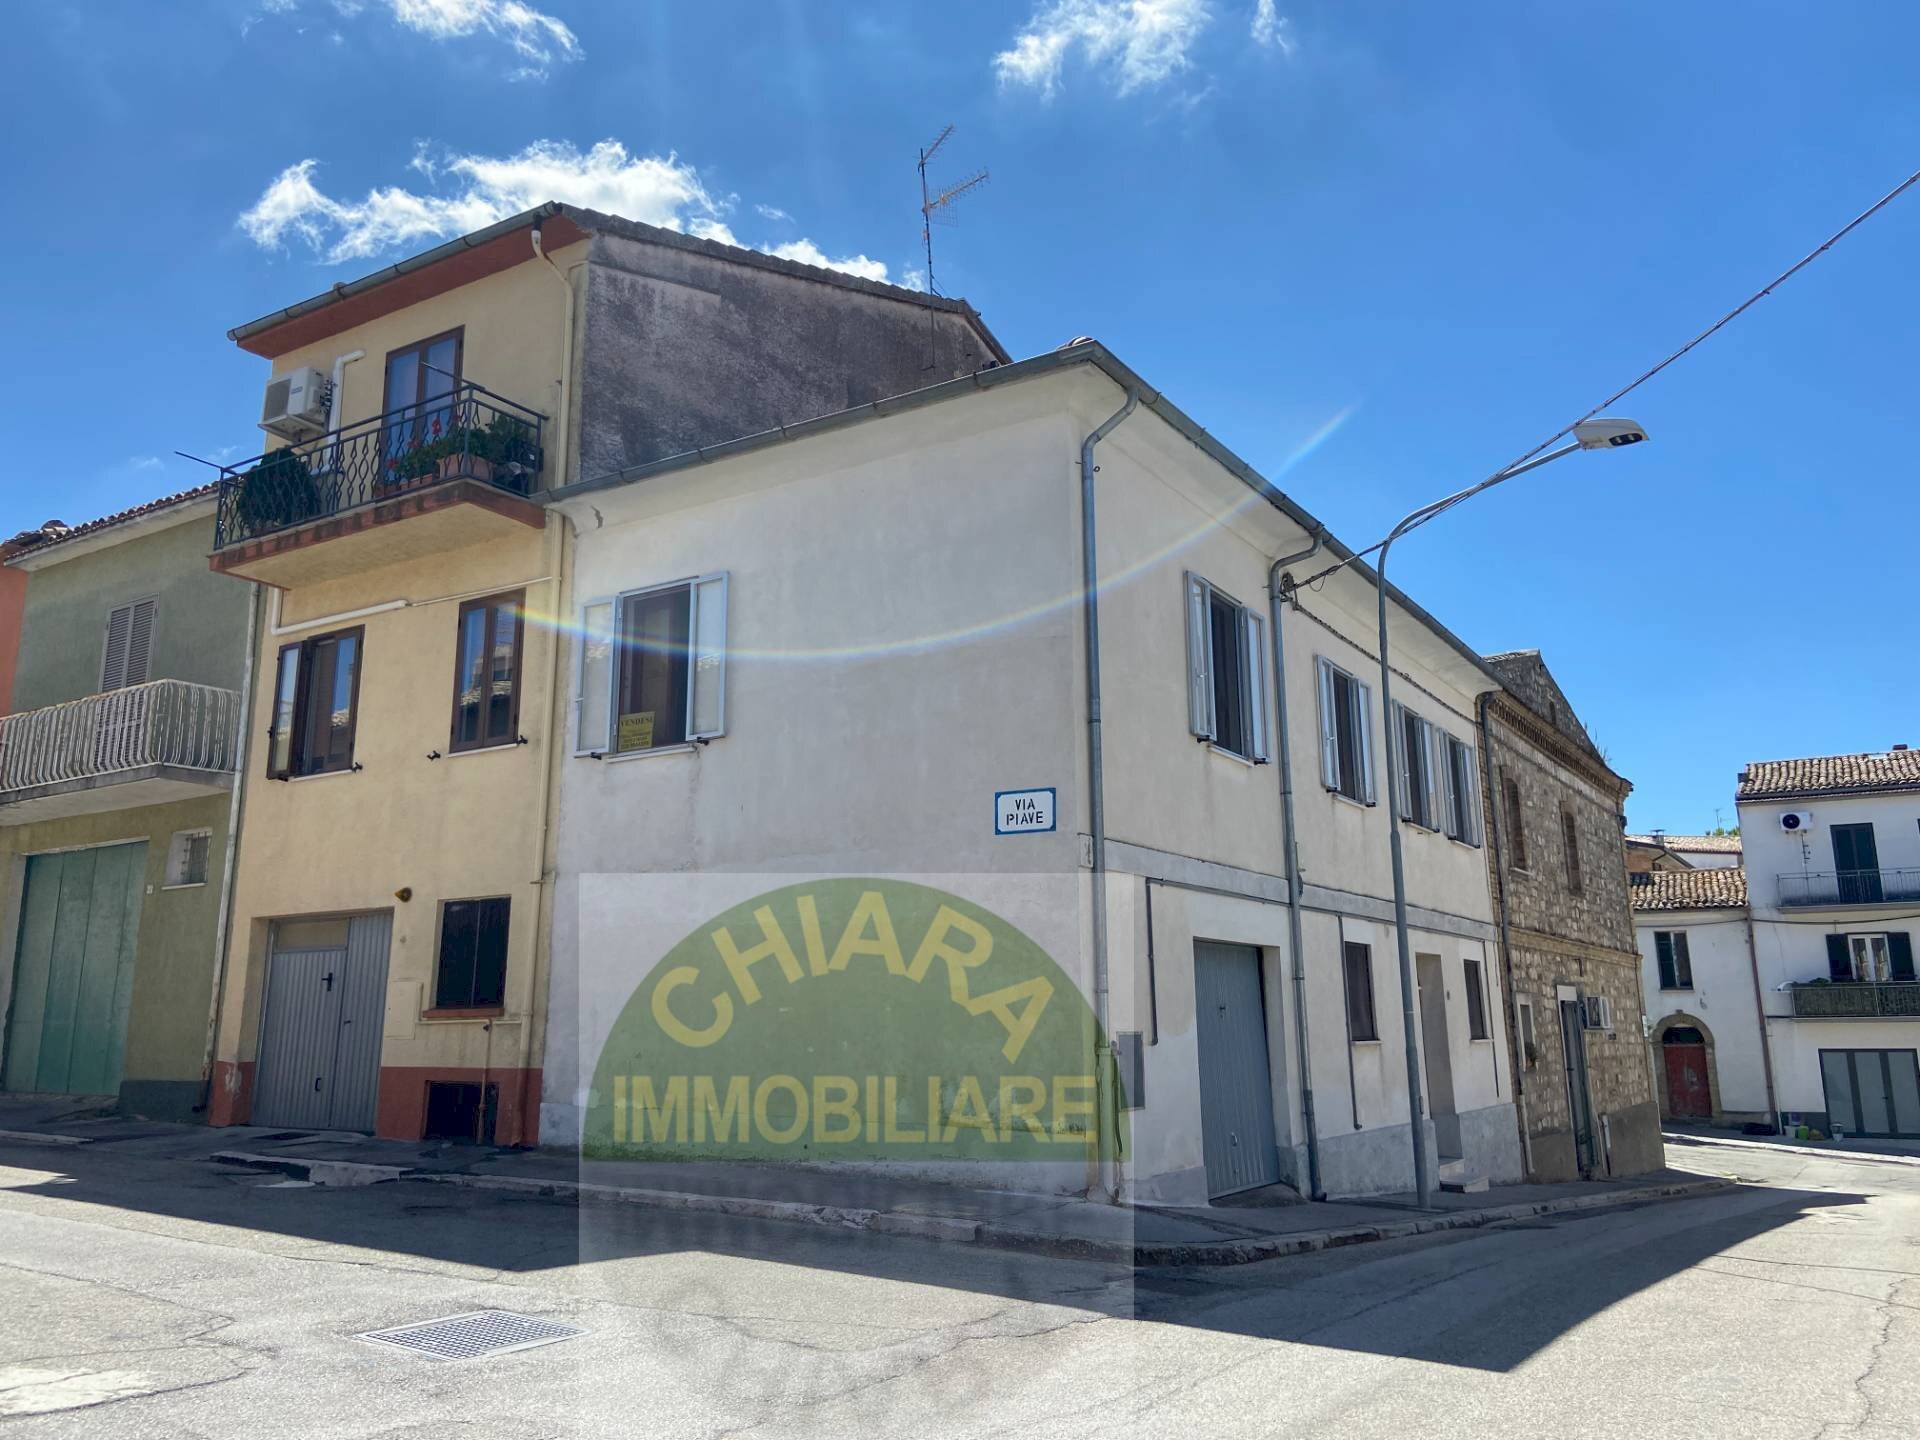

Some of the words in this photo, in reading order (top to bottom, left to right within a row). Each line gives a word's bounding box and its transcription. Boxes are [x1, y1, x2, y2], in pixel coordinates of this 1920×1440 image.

[620, 716, 653, 728] VENDESI
[1015, 798, 1036, 811] VIA
[1006, 811, 1044, 826] PIAVE
